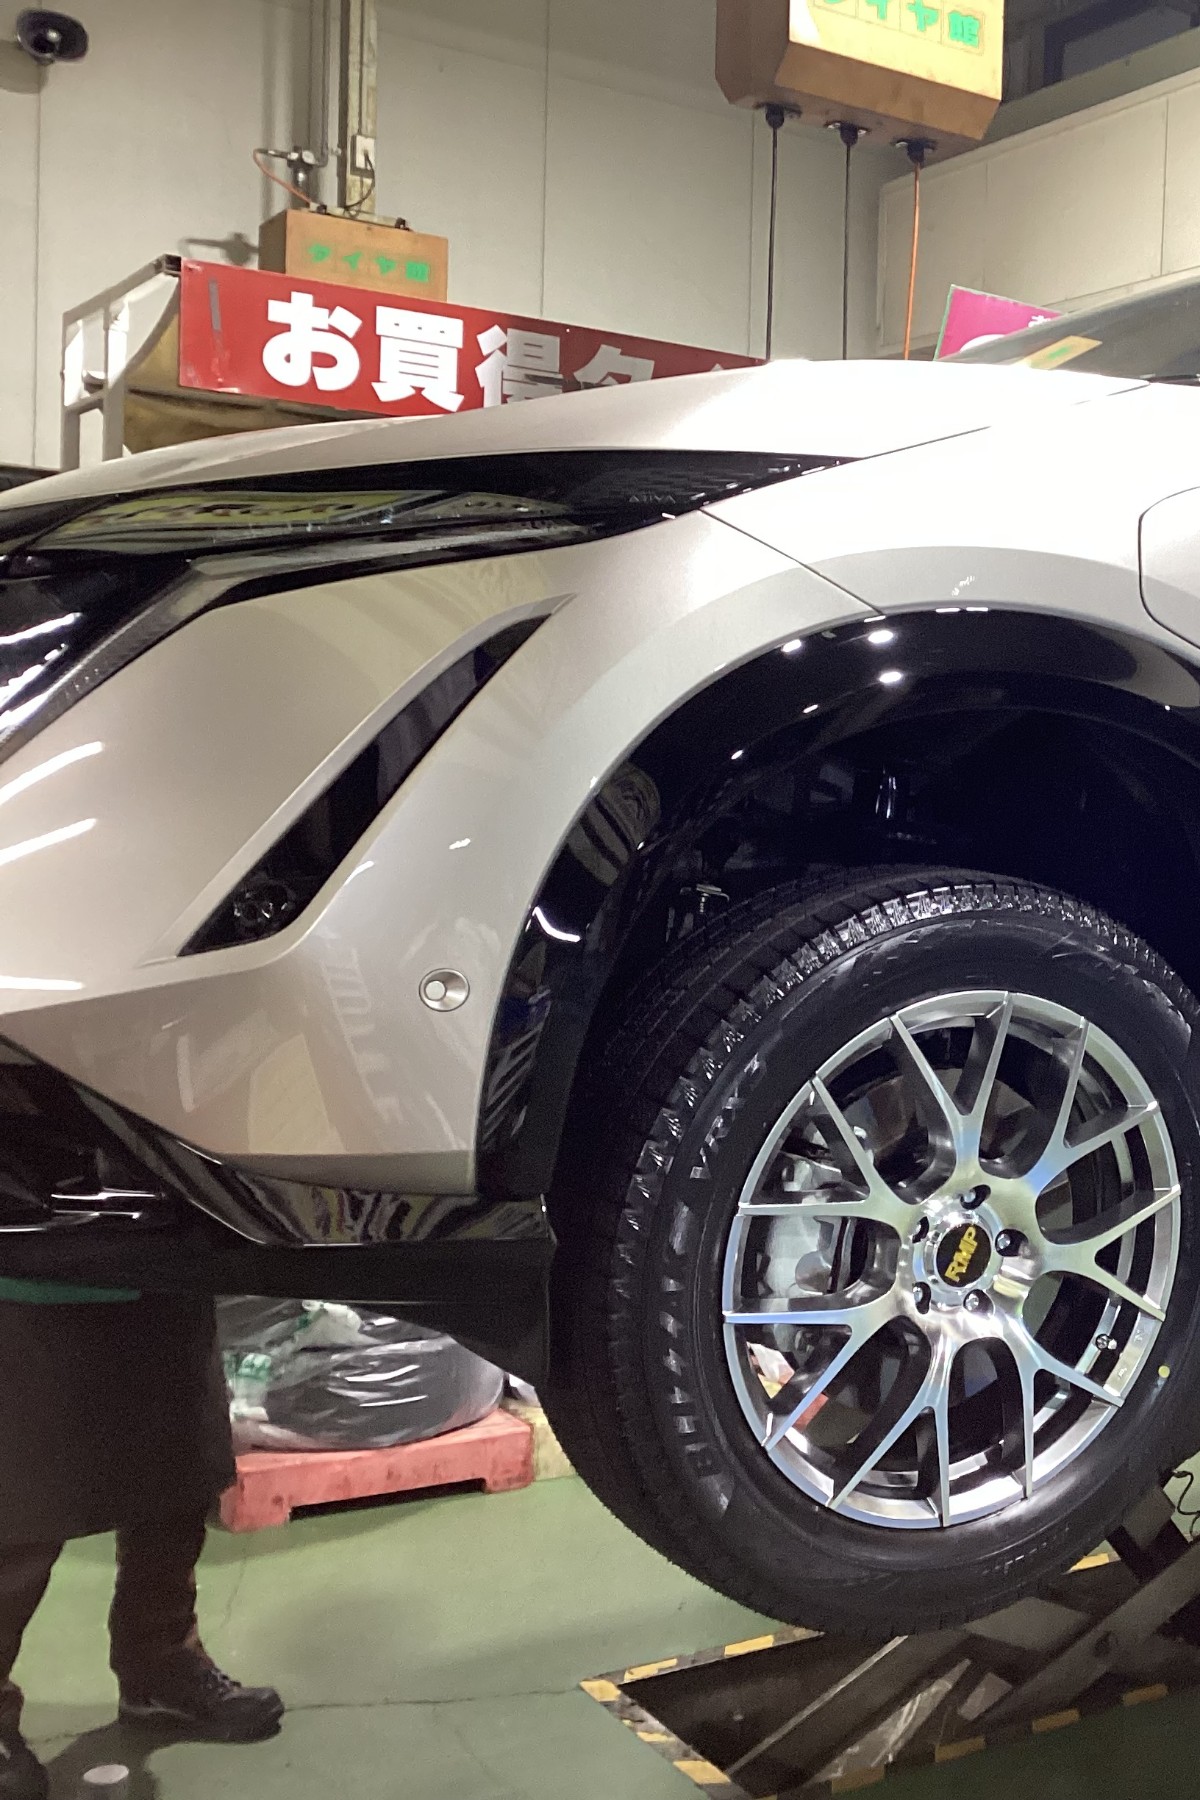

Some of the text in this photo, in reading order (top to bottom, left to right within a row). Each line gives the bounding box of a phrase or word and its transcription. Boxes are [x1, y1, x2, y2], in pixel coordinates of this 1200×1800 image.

[823, 0, 981, 49] イヤ館
[262, 290, 726, 413] お買得タ
[944, 1225, 978, 1283] RMP
